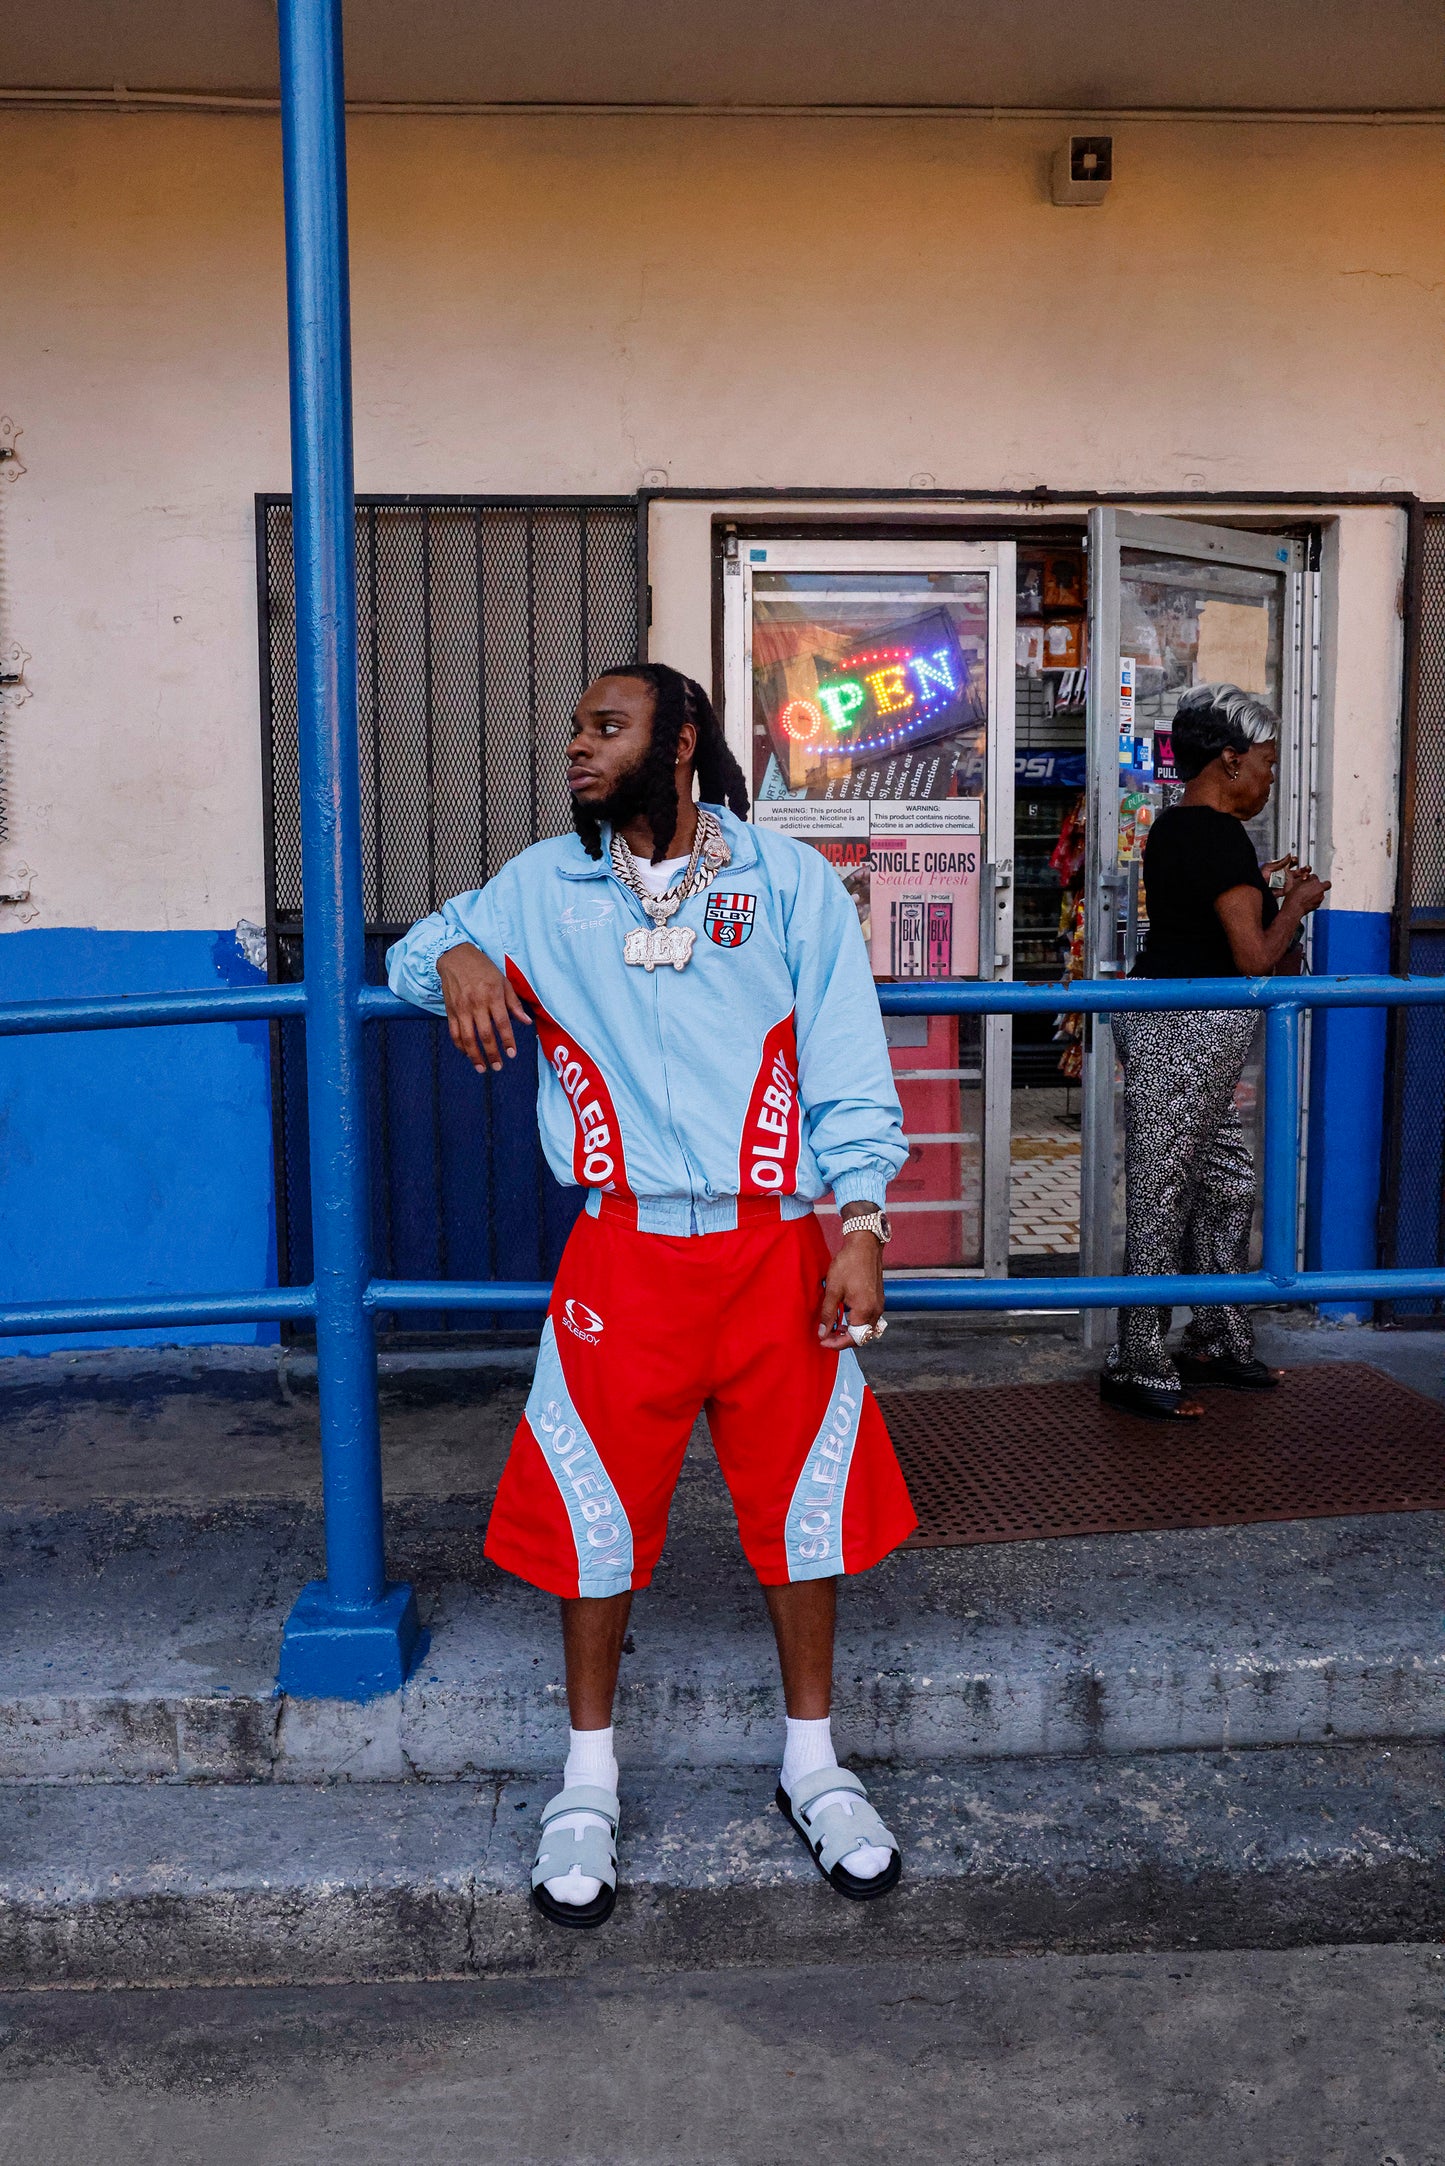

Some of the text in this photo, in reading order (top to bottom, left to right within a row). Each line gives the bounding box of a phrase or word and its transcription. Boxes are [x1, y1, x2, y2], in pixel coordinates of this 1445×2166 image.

[781, 649, 956, 740] OPEN
[866, 771, 880, 798] death
[885, 760, 897, 786] acute
[909, 761, 927, 797] asthma,
[921, 757, 940, 798] function.
[1158, 767, 1178, 779] PULL
[826, 807, 852, 815] product
[889, 813, 915, 821] product
[870, 852, 975, 873] SINGLE CIGARS
[876, 871, 969, 886] Sealed Fresh
[709, 909, 752, 922] SLBY
[903, 919, 920, 942] BLK
[930, 919, 948, 942] BLK
[750, 1049, 795, 1196] OLEBOY
[562, 1316, 601, 1346] SOLEBOY
[539, 1400, 624, 1567] SOLEBOY
